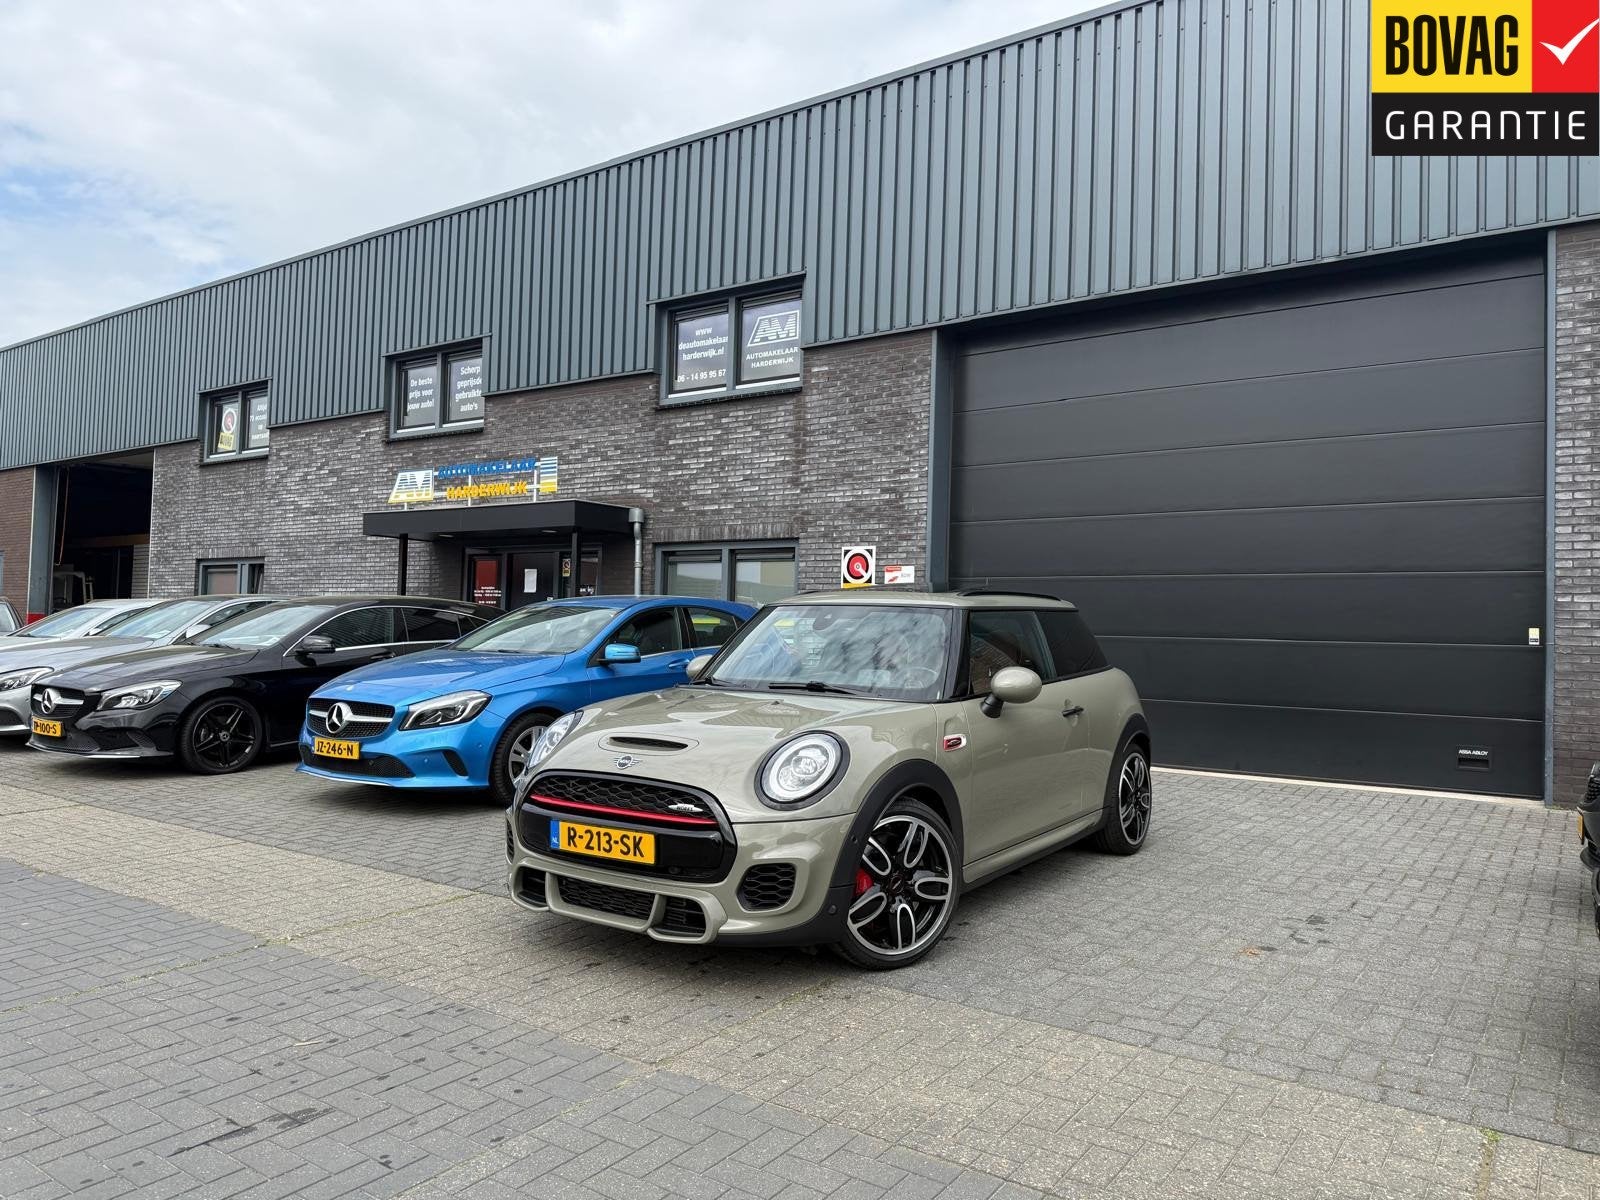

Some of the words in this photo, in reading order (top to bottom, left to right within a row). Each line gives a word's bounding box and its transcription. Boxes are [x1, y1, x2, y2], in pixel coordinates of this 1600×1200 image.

[678, 336, 728, 350] deautomakelaar
[682, 346, 725, 361] harderwijk.nl
[746, 347, 798, 360] AUTOMAKELAAR
[751, 357, 794, 369] HARDERWIJK
[460, 366, 480, 376] Scherp
[410, 379, 419, 387] De
[418, 377, 433, 386] beste
[409, 390, 421, 399] prijs
[421, 388, 434, 397] voor
[460, 403, 479, 412] auto's
[437, 457, 537, 480] AUTOMAKELAAR
[446, 480, 528, 500] HARDERWIJK
[316, 740, 354, 757] JZ-246-N
[567, 826, 645, 858] R-213-SK
